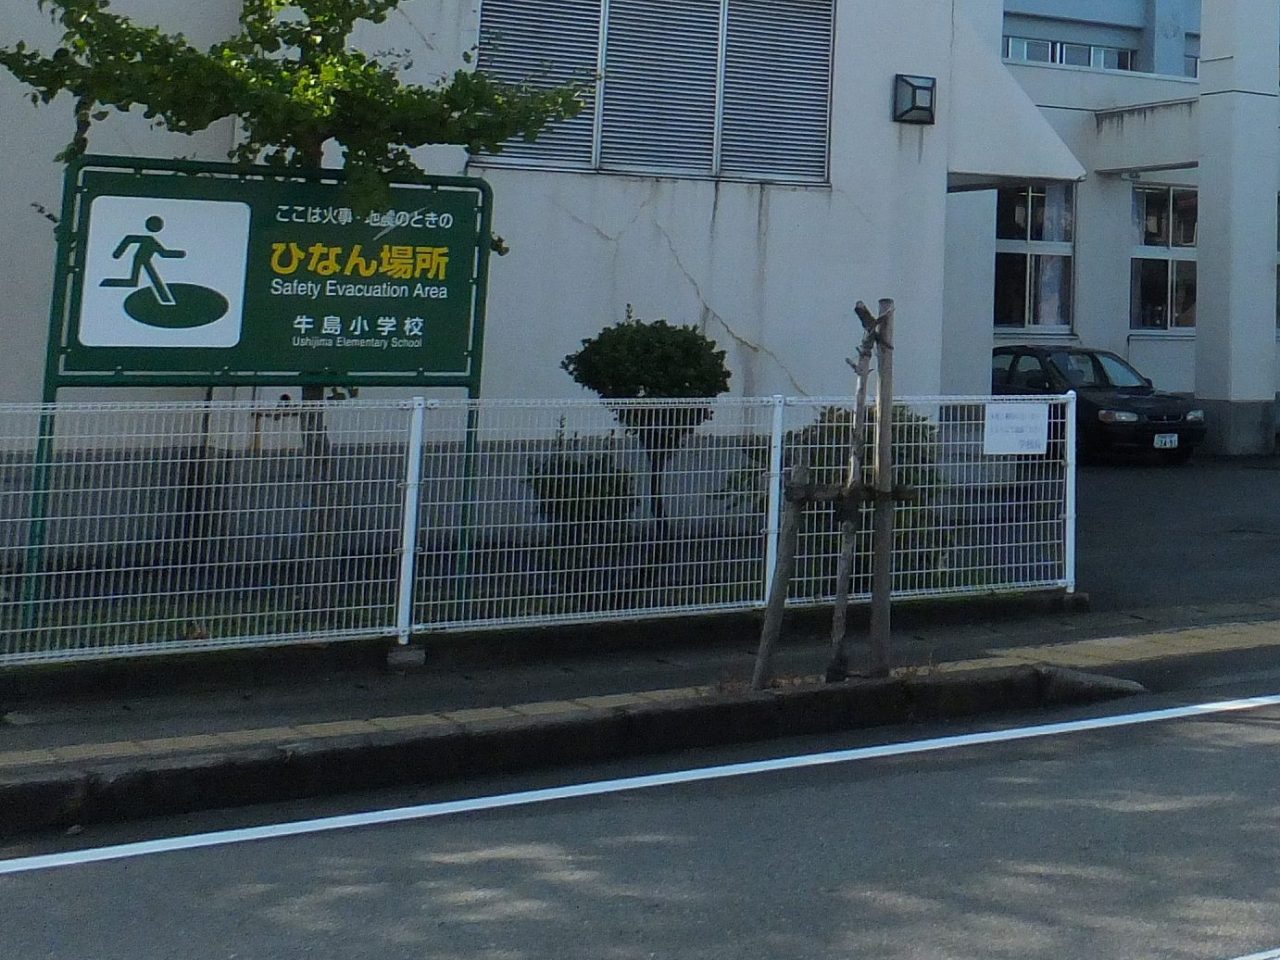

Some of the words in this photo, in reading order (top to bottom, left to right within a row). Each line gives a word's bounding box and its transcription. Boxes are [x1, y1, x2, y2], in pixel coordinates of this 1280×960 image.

[271, 242, 449, 280] ひなん場所
[271, 279, 321, 299] Safety
[326, 281, 409, 298] Evacuation
[413, 283, 448, 299] Area
[293, 315, 424, 336] 牛島小学校
[293, 337, 333, 348] Ushijima
[336, 337, 388, 349] Elementary
[391, 338, 423, 348] School
